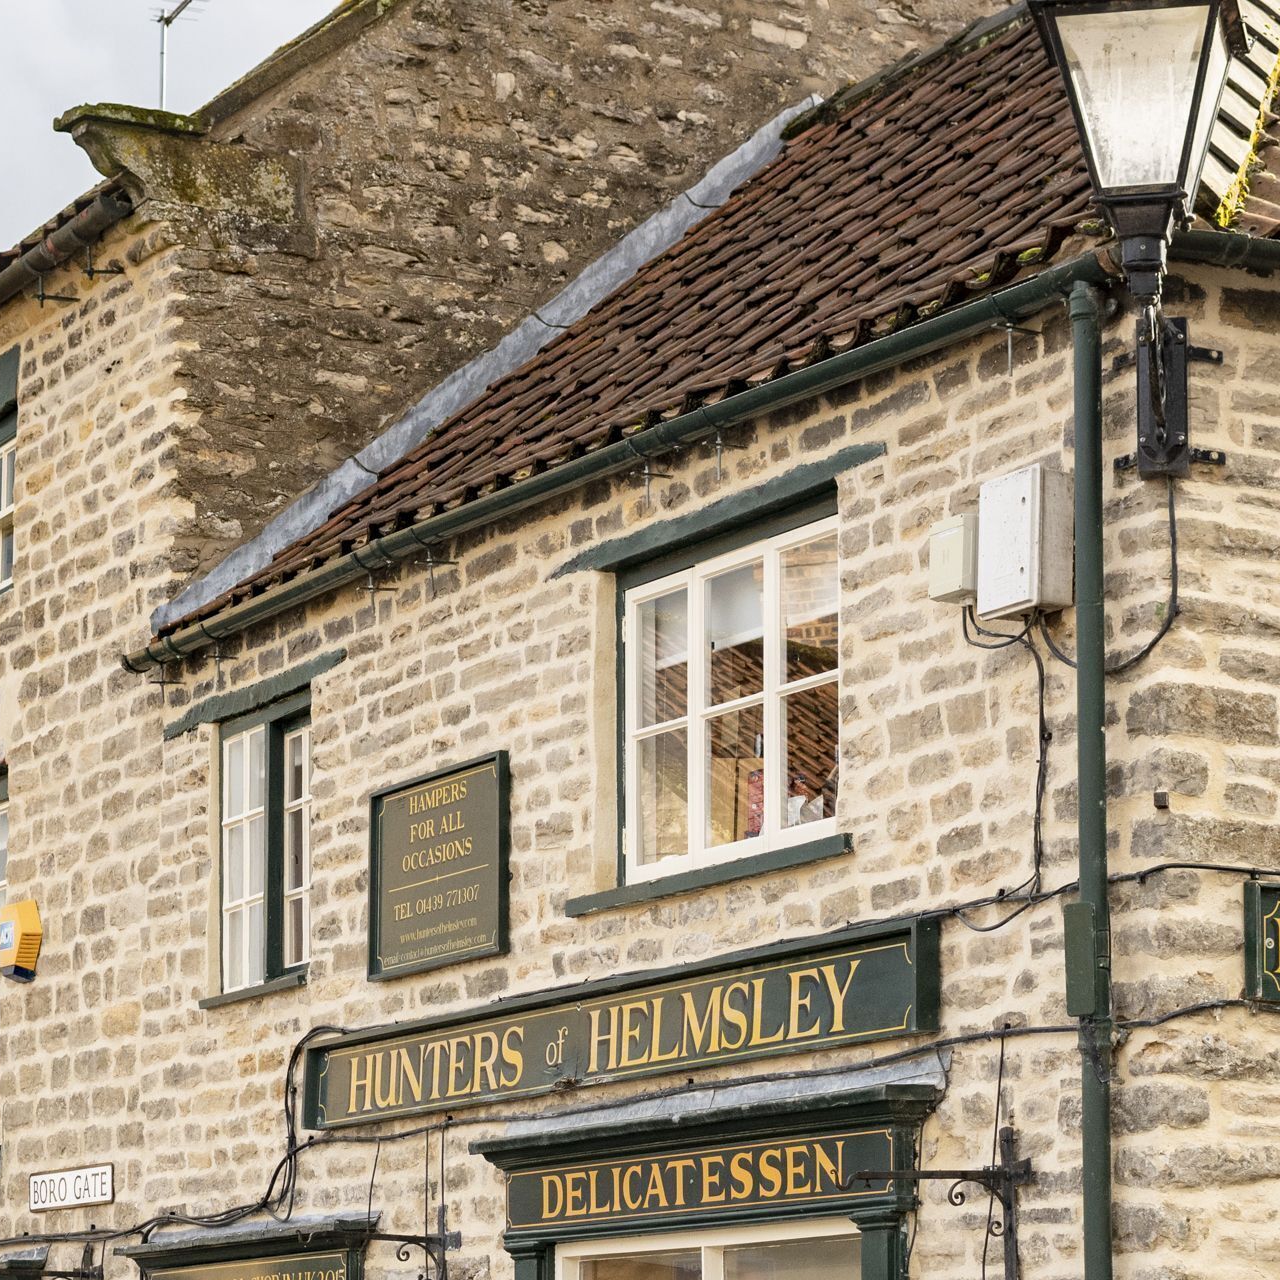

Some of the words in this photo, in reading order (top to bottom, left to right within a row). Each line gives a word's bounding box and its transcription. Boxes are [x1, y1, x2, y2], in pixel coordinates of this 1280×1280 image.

[409, 780, 467, 815] HAMPERS
[410, 819, 434, 843] FOR
[439, 811, 464, 832] ALL
[402, 837, 472, 872] OCCASIONS
[394, 903, 413, 921] TEL
[416, 895, 443, 915] 01439
[446, 884, 480, 906] 771307
[347, 1026, 524, 1113] HUNTERS
[545, 1026, 568, 1066] of
[587, 959, 860, 1073] HELMSLEY
[34, 1178, 67, 1204] BORO
[74, 1172, 107, 1200] GATE
[541, 1141, 845, 1219] DELICATESSEN
